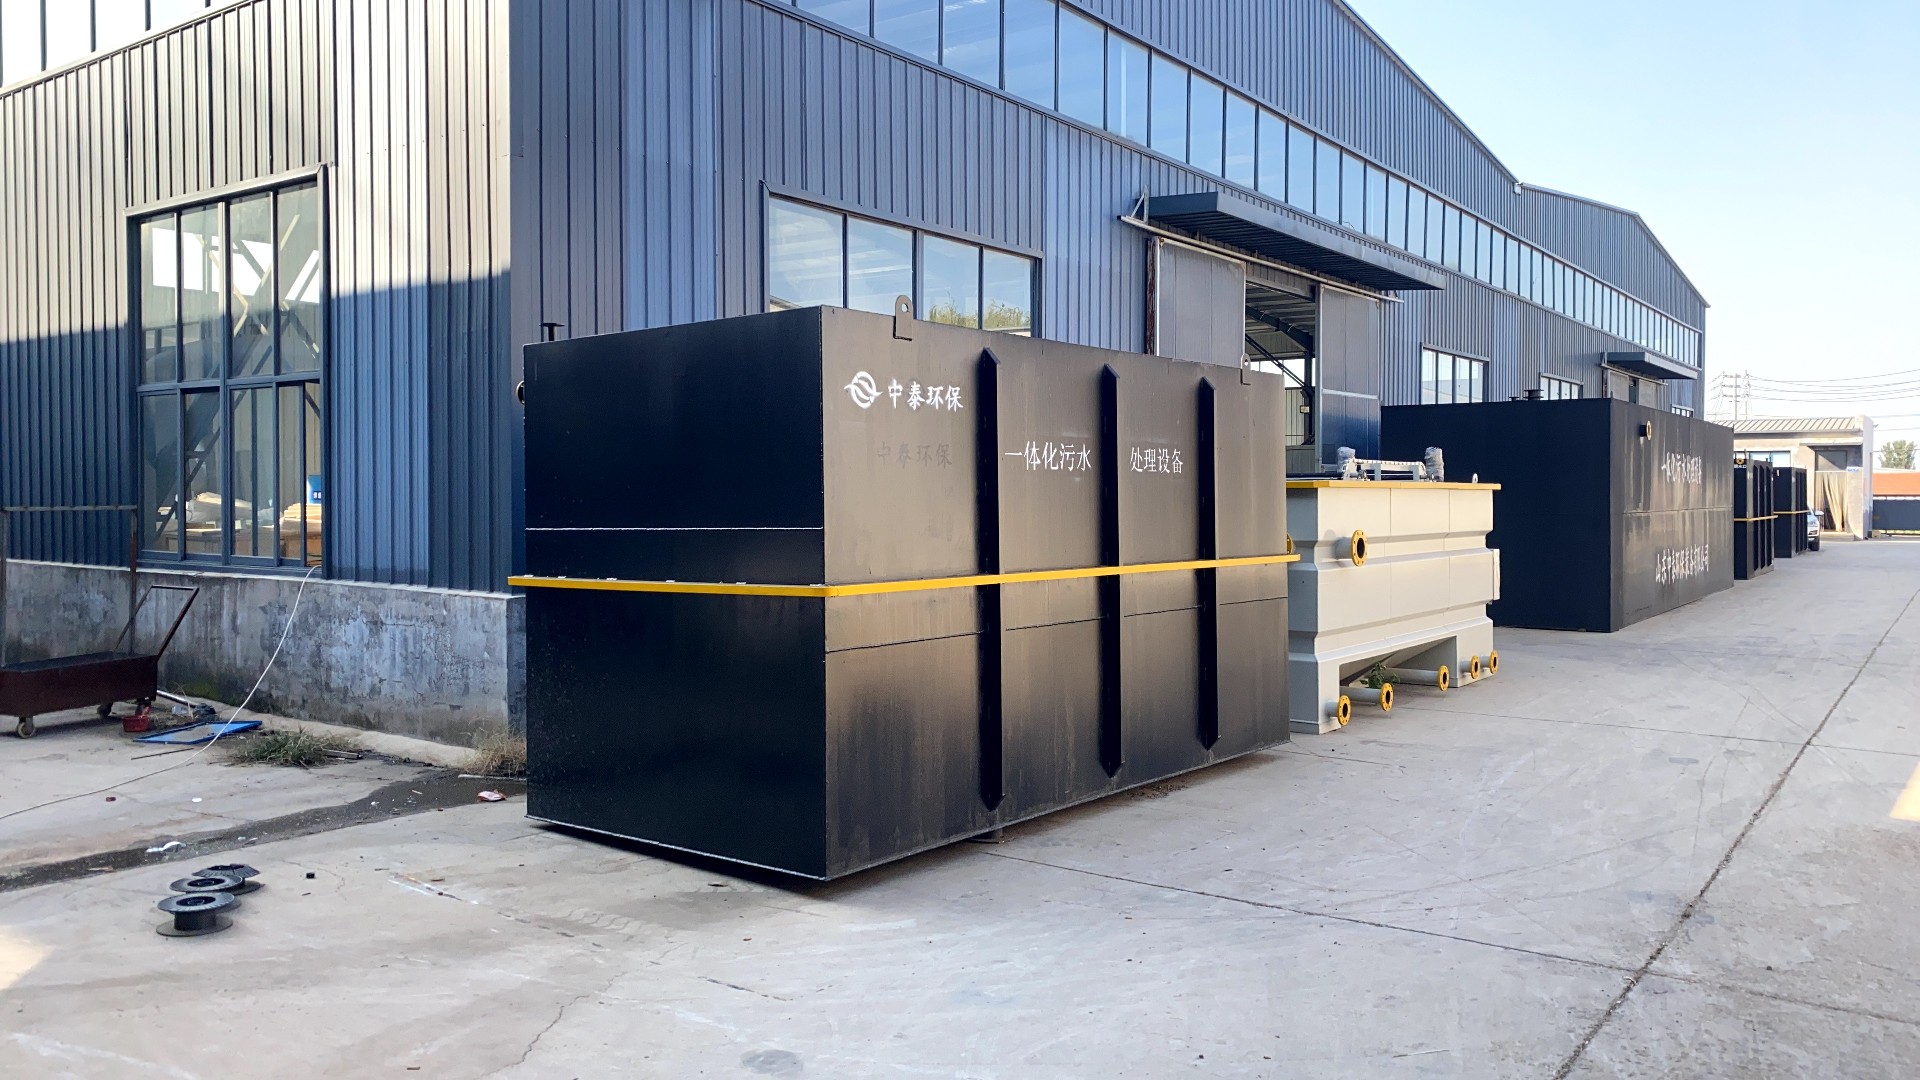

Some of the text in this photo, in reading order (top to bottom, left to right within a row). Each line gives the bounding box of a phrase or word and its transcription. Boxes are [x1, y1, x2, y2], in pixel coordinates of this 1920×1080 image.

[887, 378, 964, 412] 中泰环保
[1004, 441, 1184, 475] 一体化污水 处理设备
